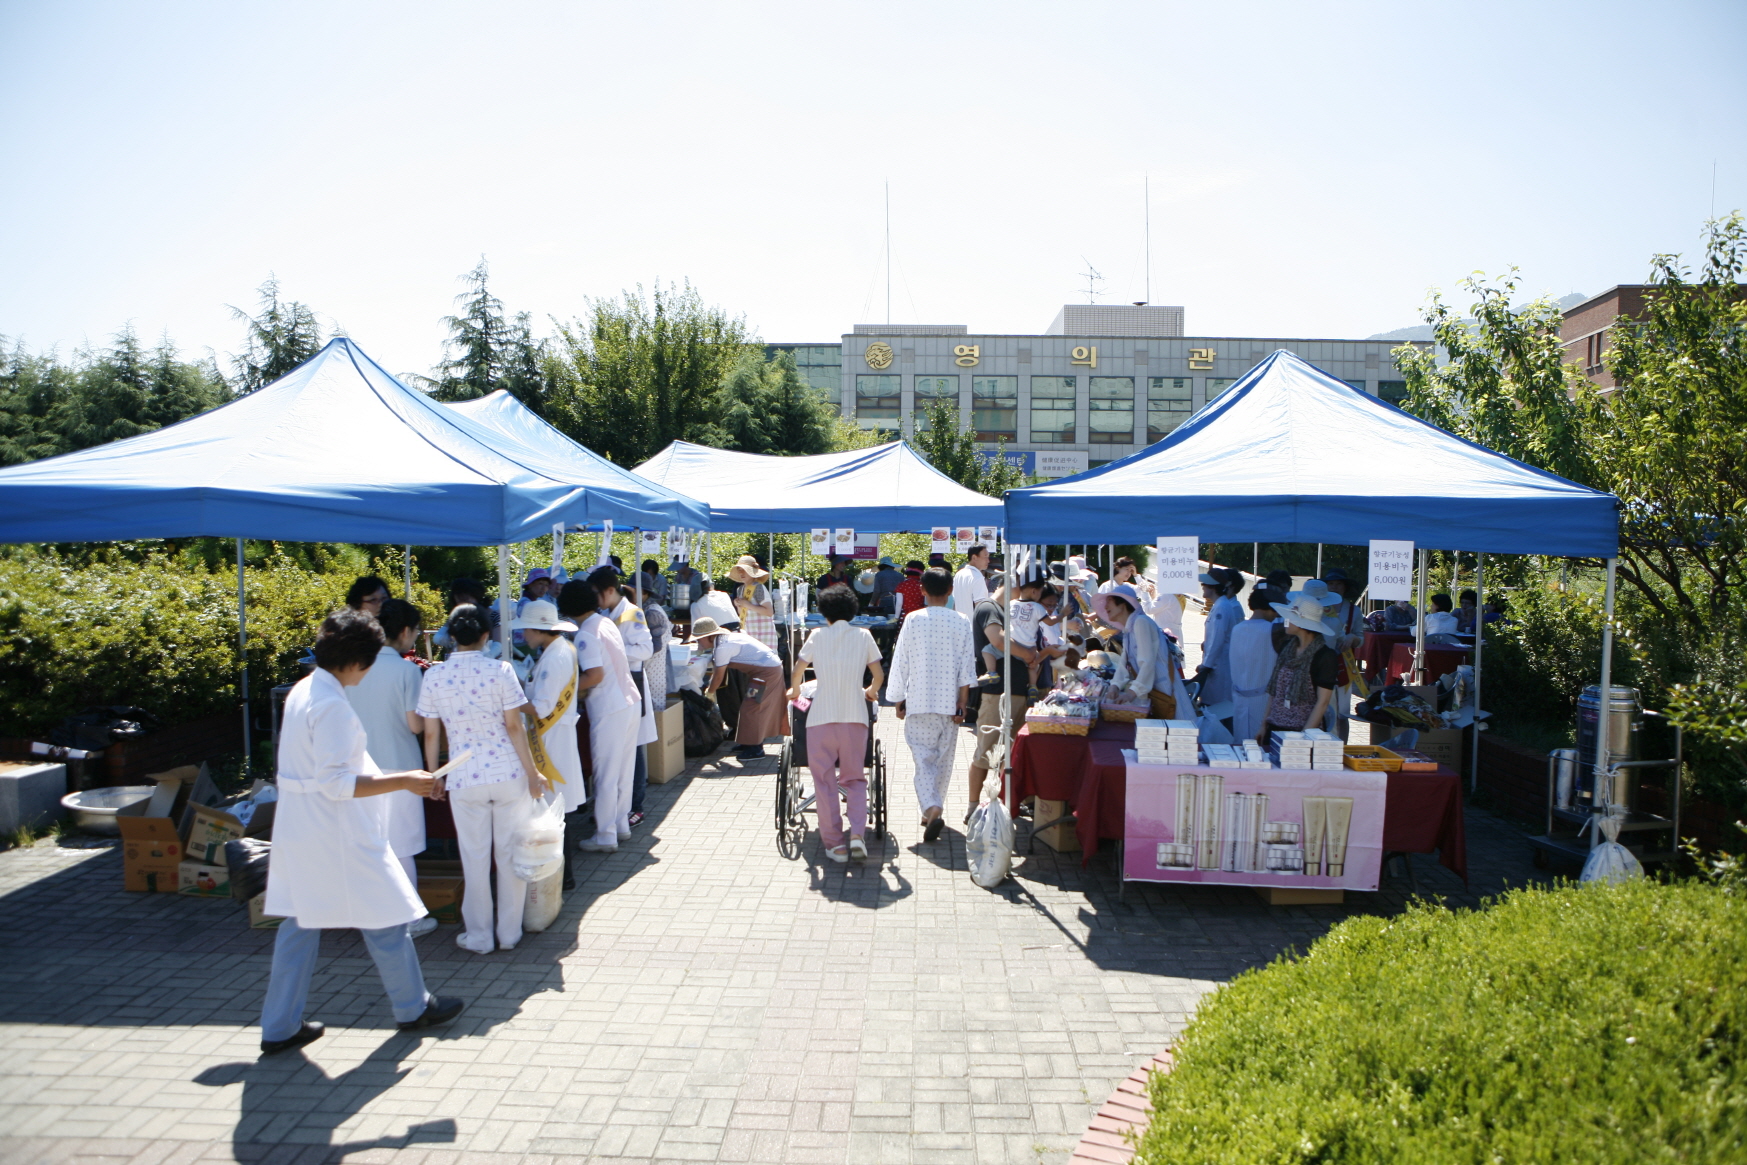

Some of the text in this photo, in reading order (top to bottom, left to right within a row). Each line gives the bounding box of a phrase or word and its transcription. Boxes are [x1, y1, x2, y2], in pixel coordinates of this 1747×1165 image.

[1161, 557, 1195, 566] 미용비누
[1373, 561, 1409, 571] 미용비누
[1162, 570, 1193, 579] 6,000원
[1374, 575, 1406, 585] 6,000원
